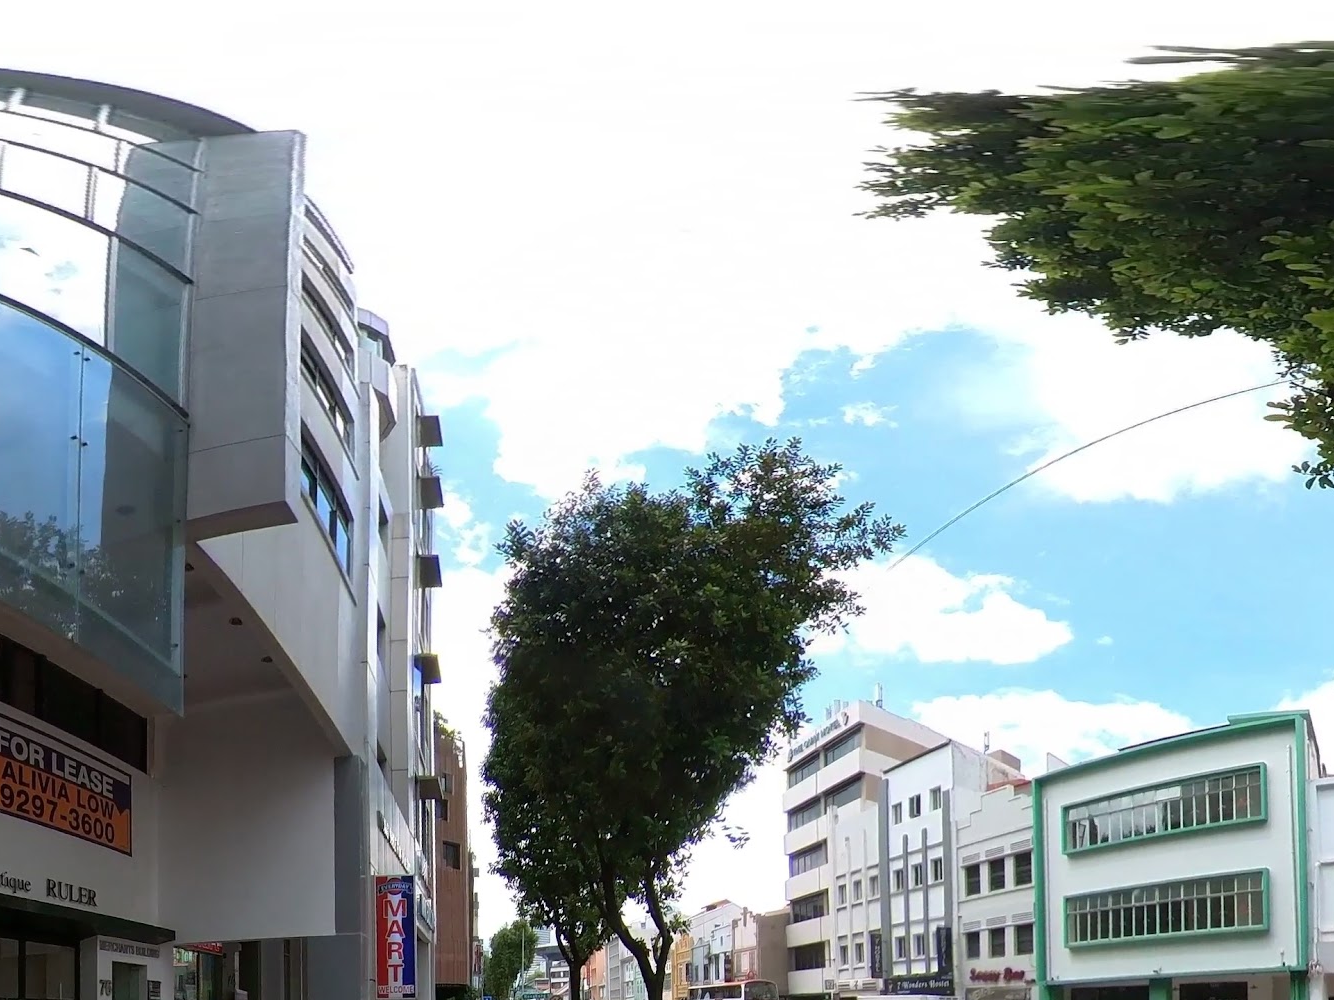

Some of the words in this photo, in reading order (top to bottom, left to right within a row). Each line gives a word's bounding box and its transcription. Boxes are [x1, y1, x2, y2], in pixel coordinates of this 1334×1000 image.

[1, 760, 71, 804] ALIVIA
[76, 788, 115, 821] LOW
[51, 751, 114, 800] LEASE
[0, 783, 115, 844] 9297-3600
[46, 878, 98, 907] RULER
[135, 945, 160, 959] BUILDING
[383, 898, 408, 983] MART
[378, 985, 415, 994] WELCOME
[902, 980, 928, 989] Wonders
[929, 979, 950, 988] Hostel
